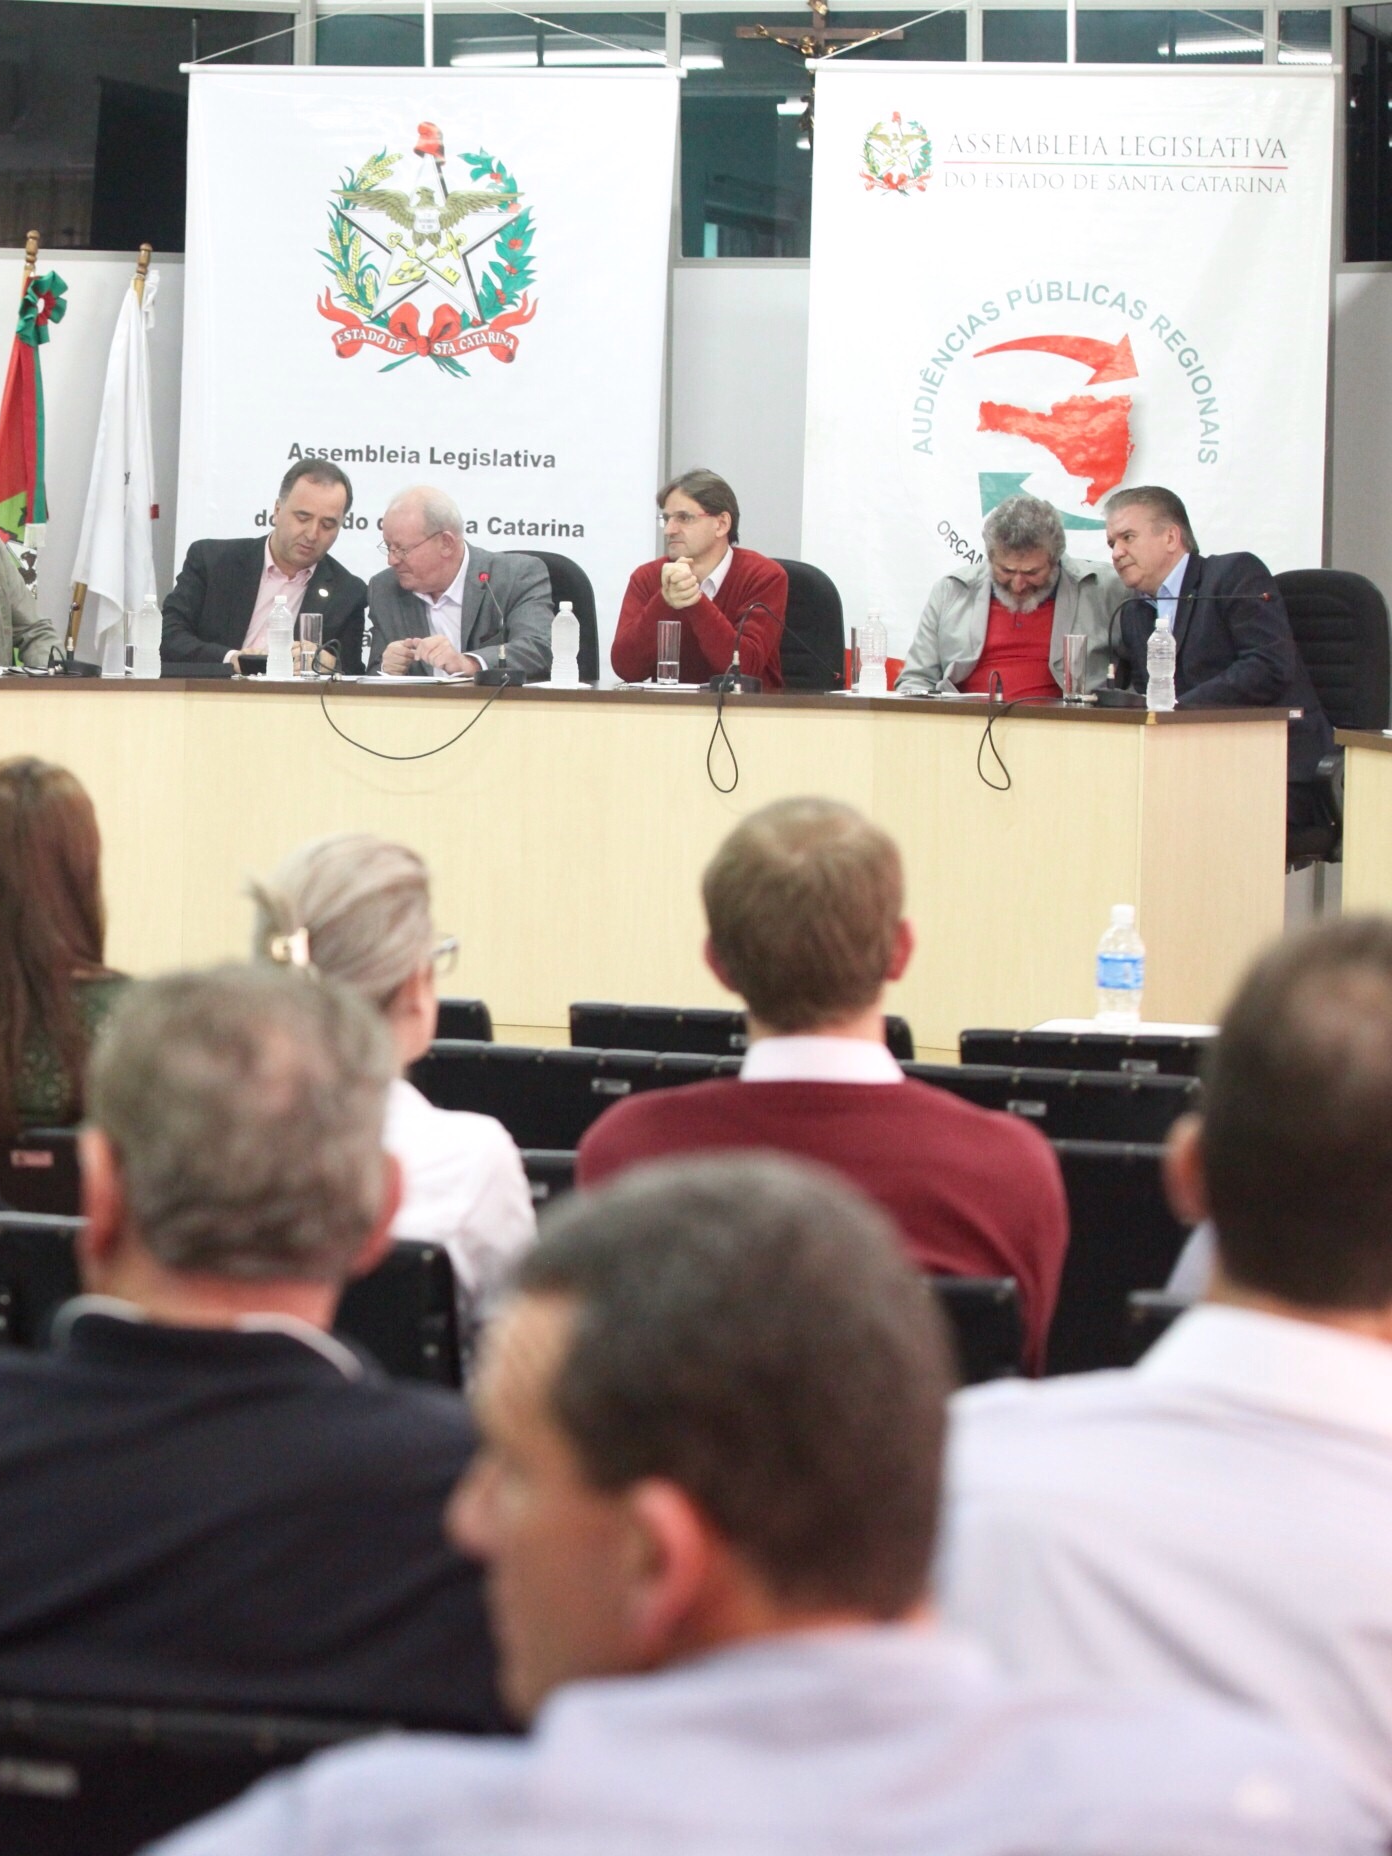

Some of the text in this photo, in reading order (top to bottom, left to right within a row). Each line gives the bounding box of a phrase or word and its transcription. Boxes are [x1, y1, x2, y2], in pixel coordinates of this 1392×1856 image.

[948, 132, 1288, 160] ASSEMBLEIA LEGISLATIVA
[943, 171, 976, 189] DO
[985, 172, 1065, 190] ESTADO
[1073, 173, 1100, 191] DE
[1107, 174, 1174, 192] SANTA
[1180, 175, 1288, 194] CATARINA
[335, 328, 386, 345] ESTADO
[387, 338, 406, 353] DE
[459, 331, 515, 350] CATARINA
[911, 279, 1221, 465] AUDIÊNCIAS PÚBLICAS REGIONAIS
[287, 442, 557, 470] Assembleia Legislativa
[487, 516, 585, 538] Catarina
